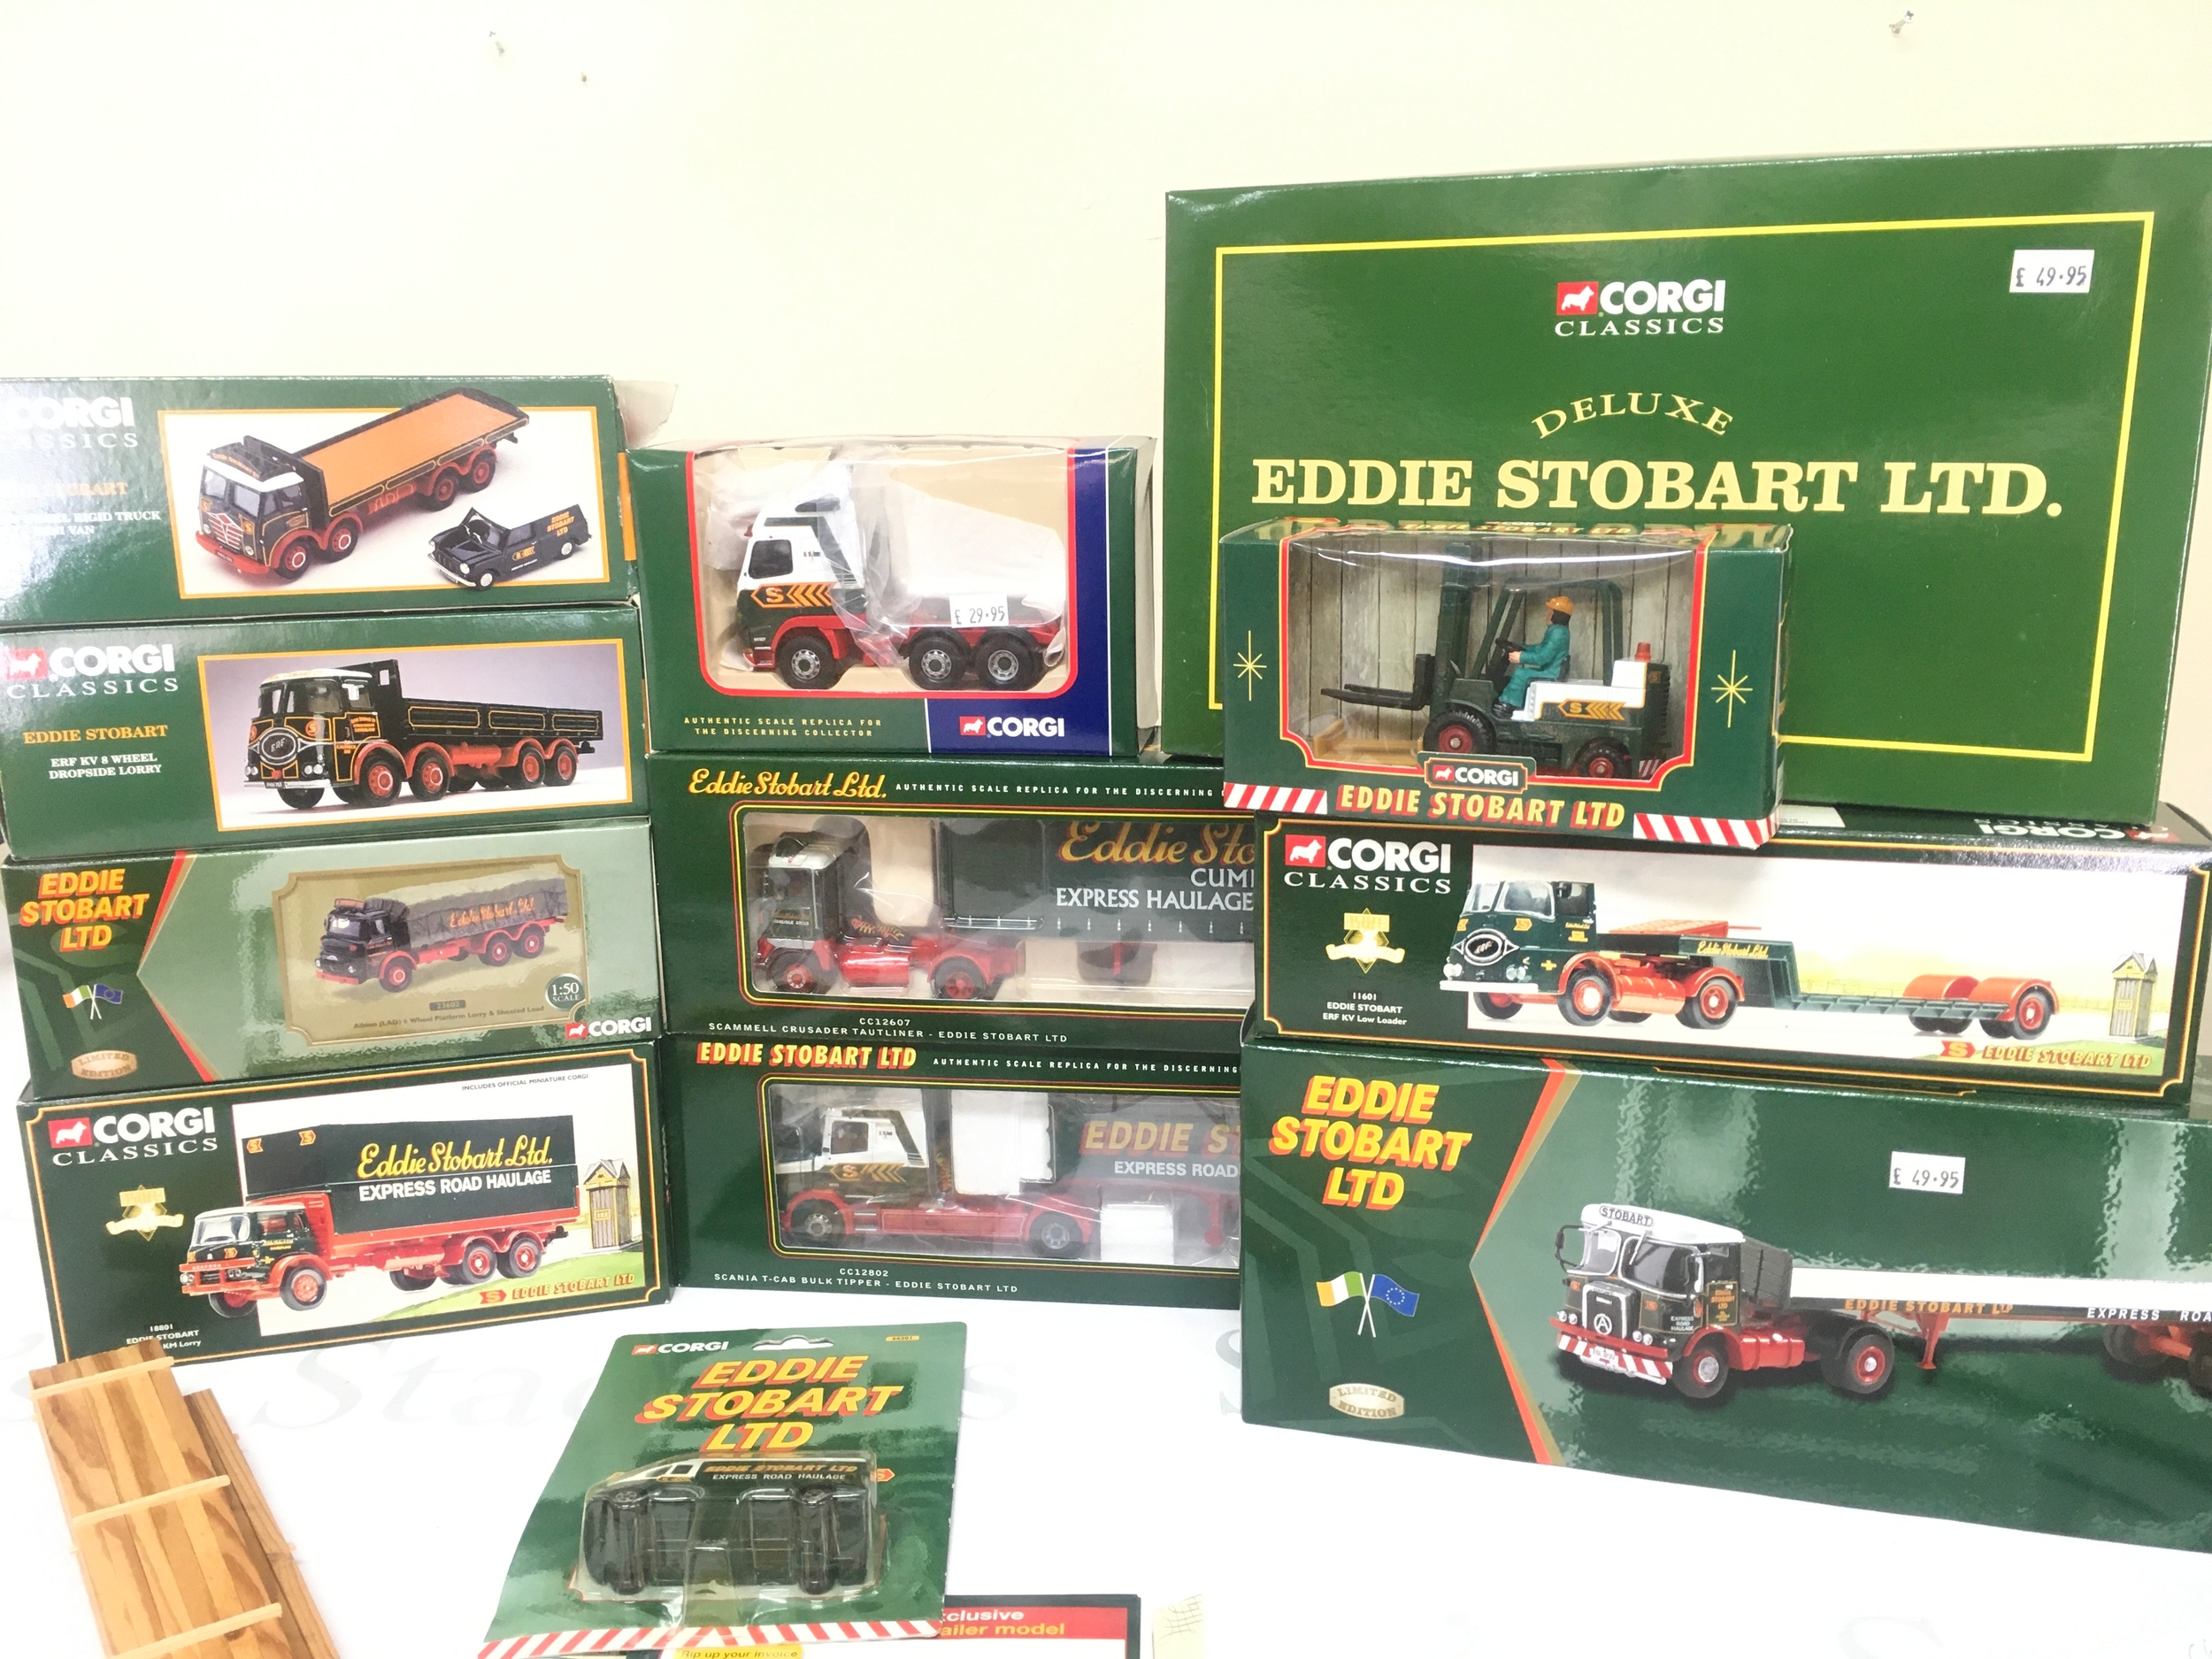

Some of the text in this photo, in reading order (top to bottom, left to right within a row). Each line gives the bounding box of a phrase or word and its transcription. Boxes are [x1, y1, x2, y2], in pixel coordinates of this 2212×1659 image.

[2016, 267, 2026, 288] £
[1600, 279, 1726, 315] CORGI
[1555, 318, 1724, 336] CLASSICS
[1532, 392, 1733, 440] DELUXE
[1252, 458, 2062, 517] EDDIE STOBART LTD.
[73, 511, 161, 523] RIGID TRUCK
[68, 525, 95, 534] VAN
[955, 609, 962, 625] £
[50, 644, 175, 678] CORGI
[7, 678, 179, 699] CLASSICS
[23, 725, 168, 744] EDDIE STOBART
[987, 716, 1064, 737] CORGI
[50, 753, 157, 768] ERF KV 8 WHEEL
[49, 764, 162, 780] DROPSIDE LORRY
[1455, 766, 1518, 787] CORGI
[688, 768, 887, 798] Eddie Stobart Ltd.
[895, 783, 964, 792] AUTHENTIC
[1017, 786, 1069, 795] REPLICA
[1336, 784, 1624, 831] EDDIE STOBART LTD
[1978, 824, 2125, 840] CORGI
[1057, 821, 1188, 864] Eddie
[1328, 838, 1451, 874] CORGI
[38, 868, 126, 899] EDDIE
[1284, 872, 1451, 895] CLASSICS
[1056, 887, 1254, 911] EXPRESS HAULAGE
[19, 893, 150, 926] STOBART
[60, 925, 112, 952] LTD
[552, 982, 580, 996] 1:50
[552, 994, 580, 1002] SCALE
[1353, 992, 1377, 1001] 11601
[1327, 1002, 1402, 1014] EDDIE STOBART
[587, 1017, 651, 1037] CORGI
[859, 1018, 910, 1026] CC12607
[1377, 1016, 1407, 1025] Loader
[709, 1023, 1067, 1043] SCAMMELL CRUSADER TAUTLINER EDDIE STOBART LTD
[78, 1052, 129, 1065] LIMITED
[696, 1041, 917, 1070] EDDIE STOBART LTD
[933, 1057, 999, 1067] AUTHENTIC
[1006, 1059, 1042, 1068] SCALE
[1049, 1060, 1100, 1070] REPLICA
[1107, 1062, 1127, 1071] FOR
[1164, 1064, 1238, 1073] DISCERNING
[1982, 1045, 2152, 1070] EDDIE STOBART LTD
[81, 1064, 133, 1078] EDITION
[1301, 1075, 1440, 1125] EDDIE
[93, 1107, 215, 1143] CORGI
[1079, 1119, 1194, 1158] EDDIE
[1268, 1116, 1473, 1171] STOBART
[52, 1138, 218, 1166] CLASSICS
[357, 1134, 553, 1179] Eddie Stobart Ltd.
[1114, 1161, 1239, 1178] EXPRESS ROAD
[1893, 1167, 1901, 1186] £
[359, 1170, 551, 1202] EXPRESS ROAD HAULAGE
[1322, 1166, 1405, 1211] LTD
[1601, 1207, 1650, 1226] STOBART
[714, 1273, 757, 1282] SCANIA
[762, 1275, 796, 1284] T-CAB
[837, 1278, 881, 1286] TIPPER
[895, 1280, 932, 1289] EDDIE
[937, 1282, 991, 1292] STOBART
[840, 1268, 888, 1277] CC12802
[512, 1273, 635, 1300] EDDIE STOBART LTD
[1844, 1298, 2013, 1315] EDDIE STOBART LTD
[2087, 1307, 2160, 1320] EXPRESS
[157, 1330, 199, 1341] STOBART
[657, 1340, 729, 1354] CORGI
[692, 1355, 870, 1389] EDDIE
[1337, 1386, 1396, 1402] LIMITED
[634, 1386, 904, 1425] STOBART
[1338, 1401, 1397, 1417] EDITION
[700, 1421, 814, 1453] LTD
[995, 1623, 1064, 1635] model
[680, 1650, 700, 1659] Rip
[754, 1649, 798, 1658] invoice
